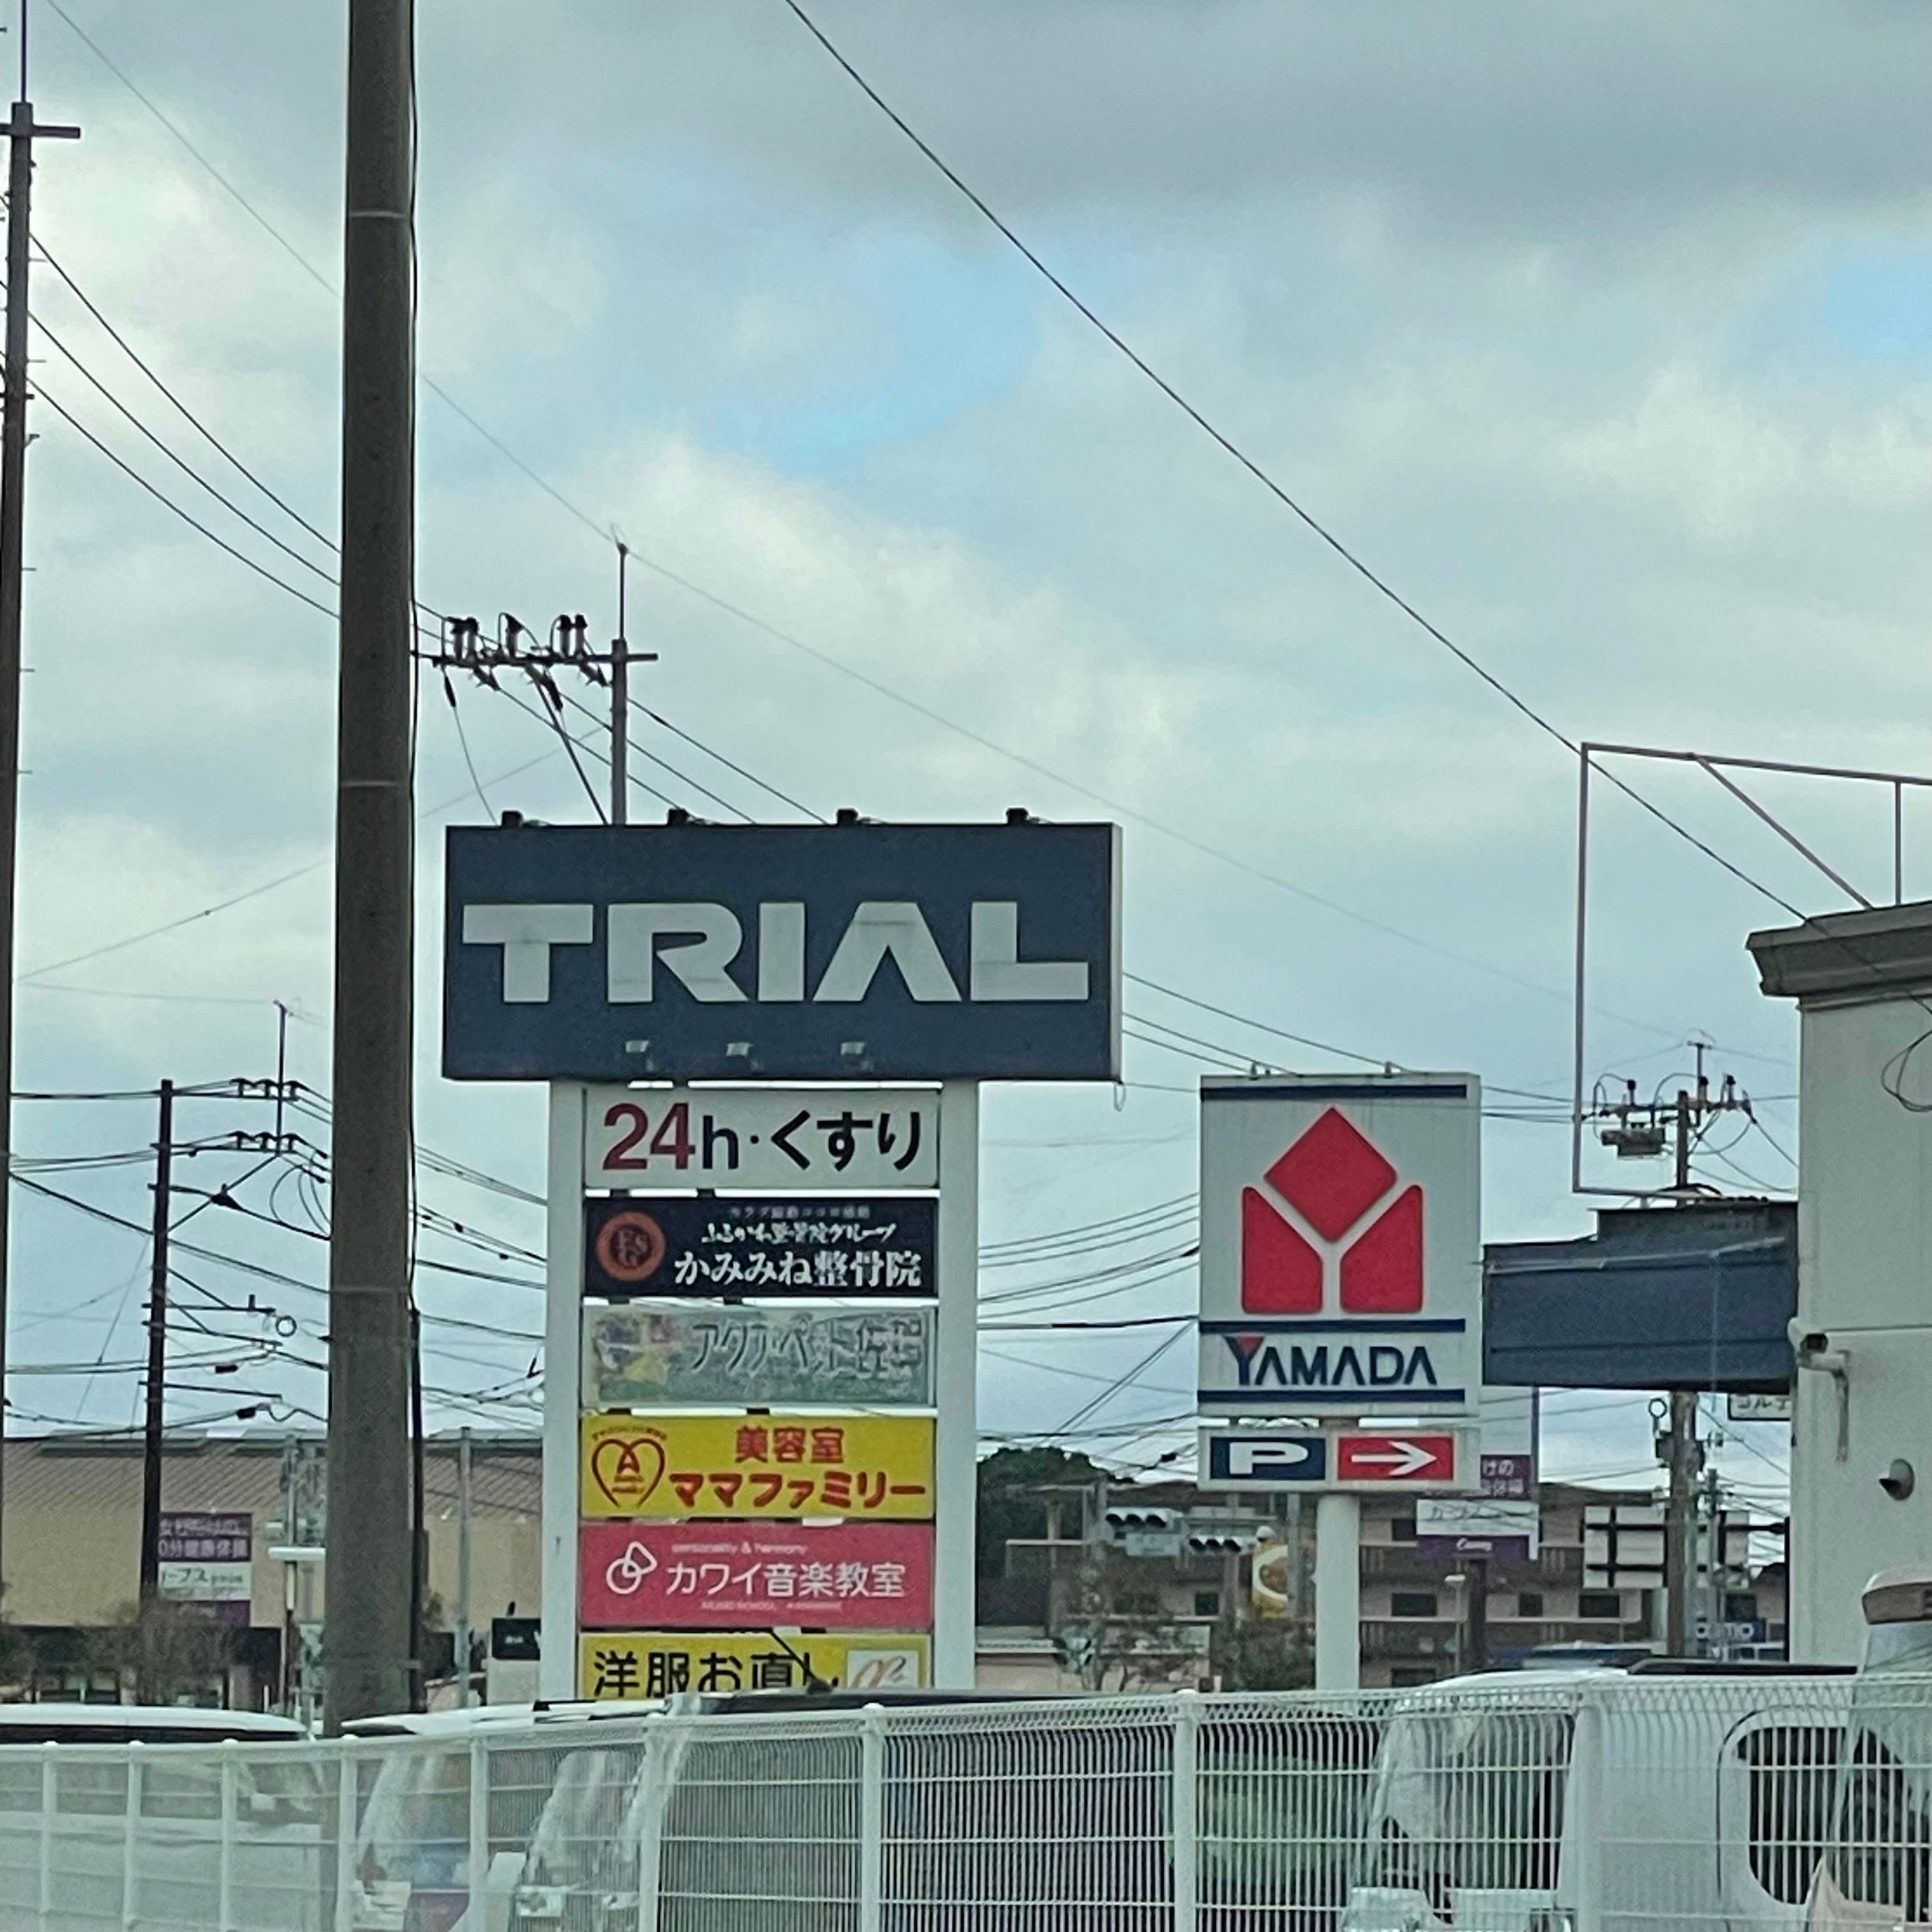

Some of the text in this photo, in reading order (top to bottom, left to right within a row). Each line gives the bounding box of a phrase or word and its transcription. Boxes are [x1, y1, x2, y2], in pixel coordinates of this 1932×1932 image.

[463, 901, 1089, 1003] TRIAL
[675, 1250, 922, 1287] かみみね整骨院
[1223, 1336, 1437, 1386] YAMADA
[735, 1425, 845, 1464] 美容室
[1229, 1442, 1308, 1475] P
[669, 1472, 926, 1508] ママファミリー
[666, 1562, 906, 1597] カワイ音楽教室
